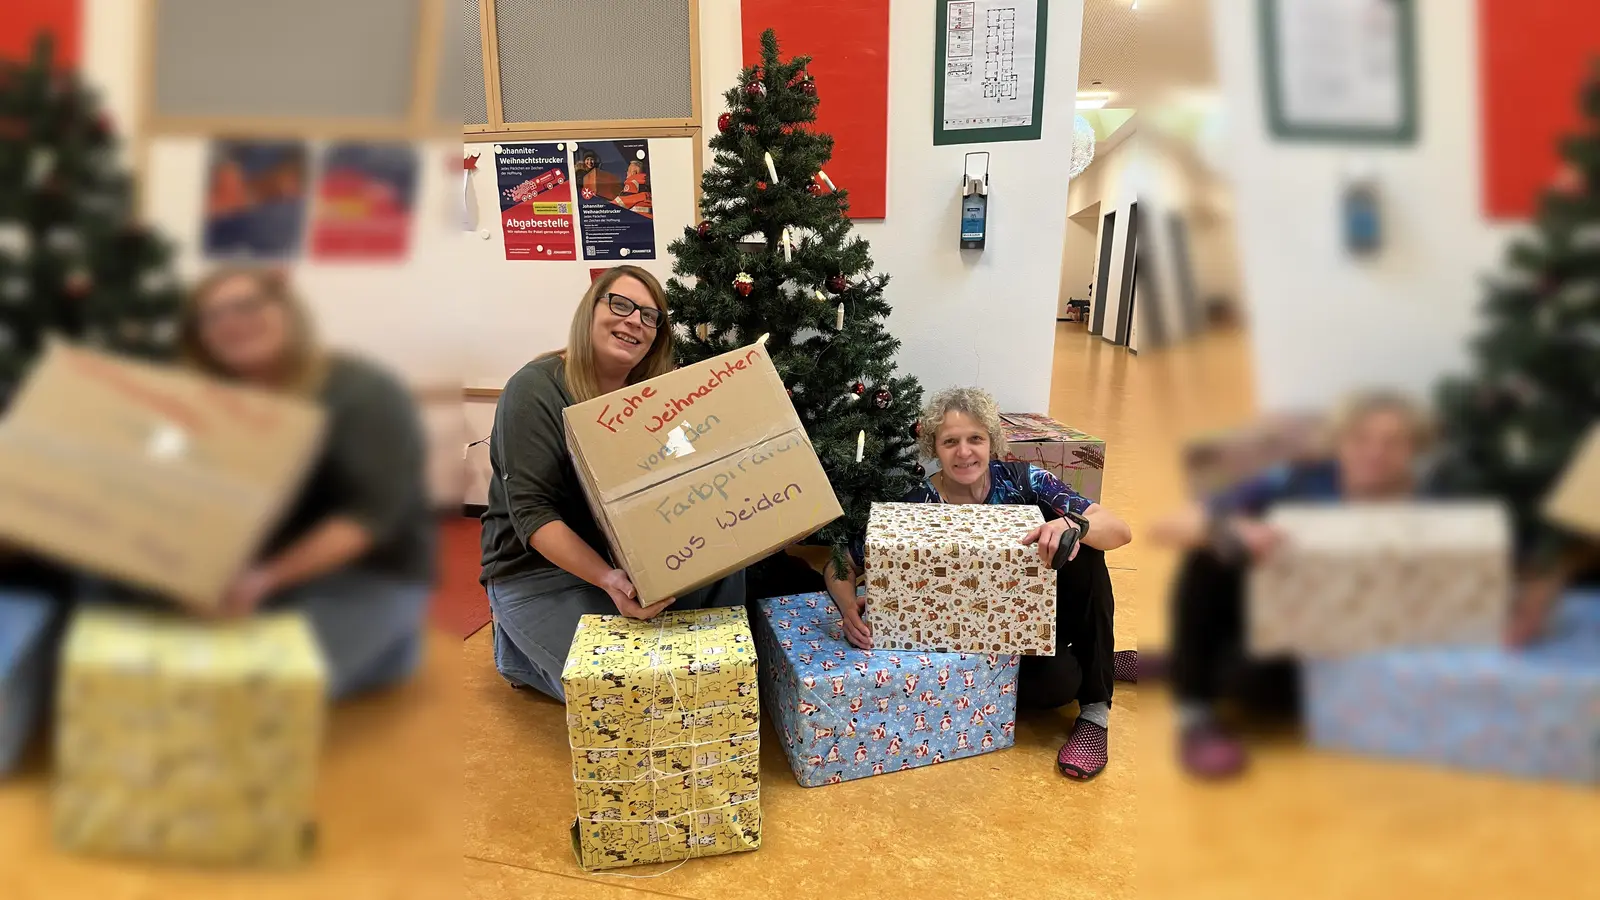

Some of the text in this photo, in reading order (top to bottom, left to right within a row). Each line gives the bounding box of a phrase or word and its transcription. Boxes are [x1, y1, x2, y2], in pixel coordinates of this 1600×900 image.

[506, 218, 569, 229] Abgabestelle
[597, 350, 762, 433] Frohe Weihnachten
[637, 414, 720, 471] von den
[665, 483, 802, 570] aus Weiden
